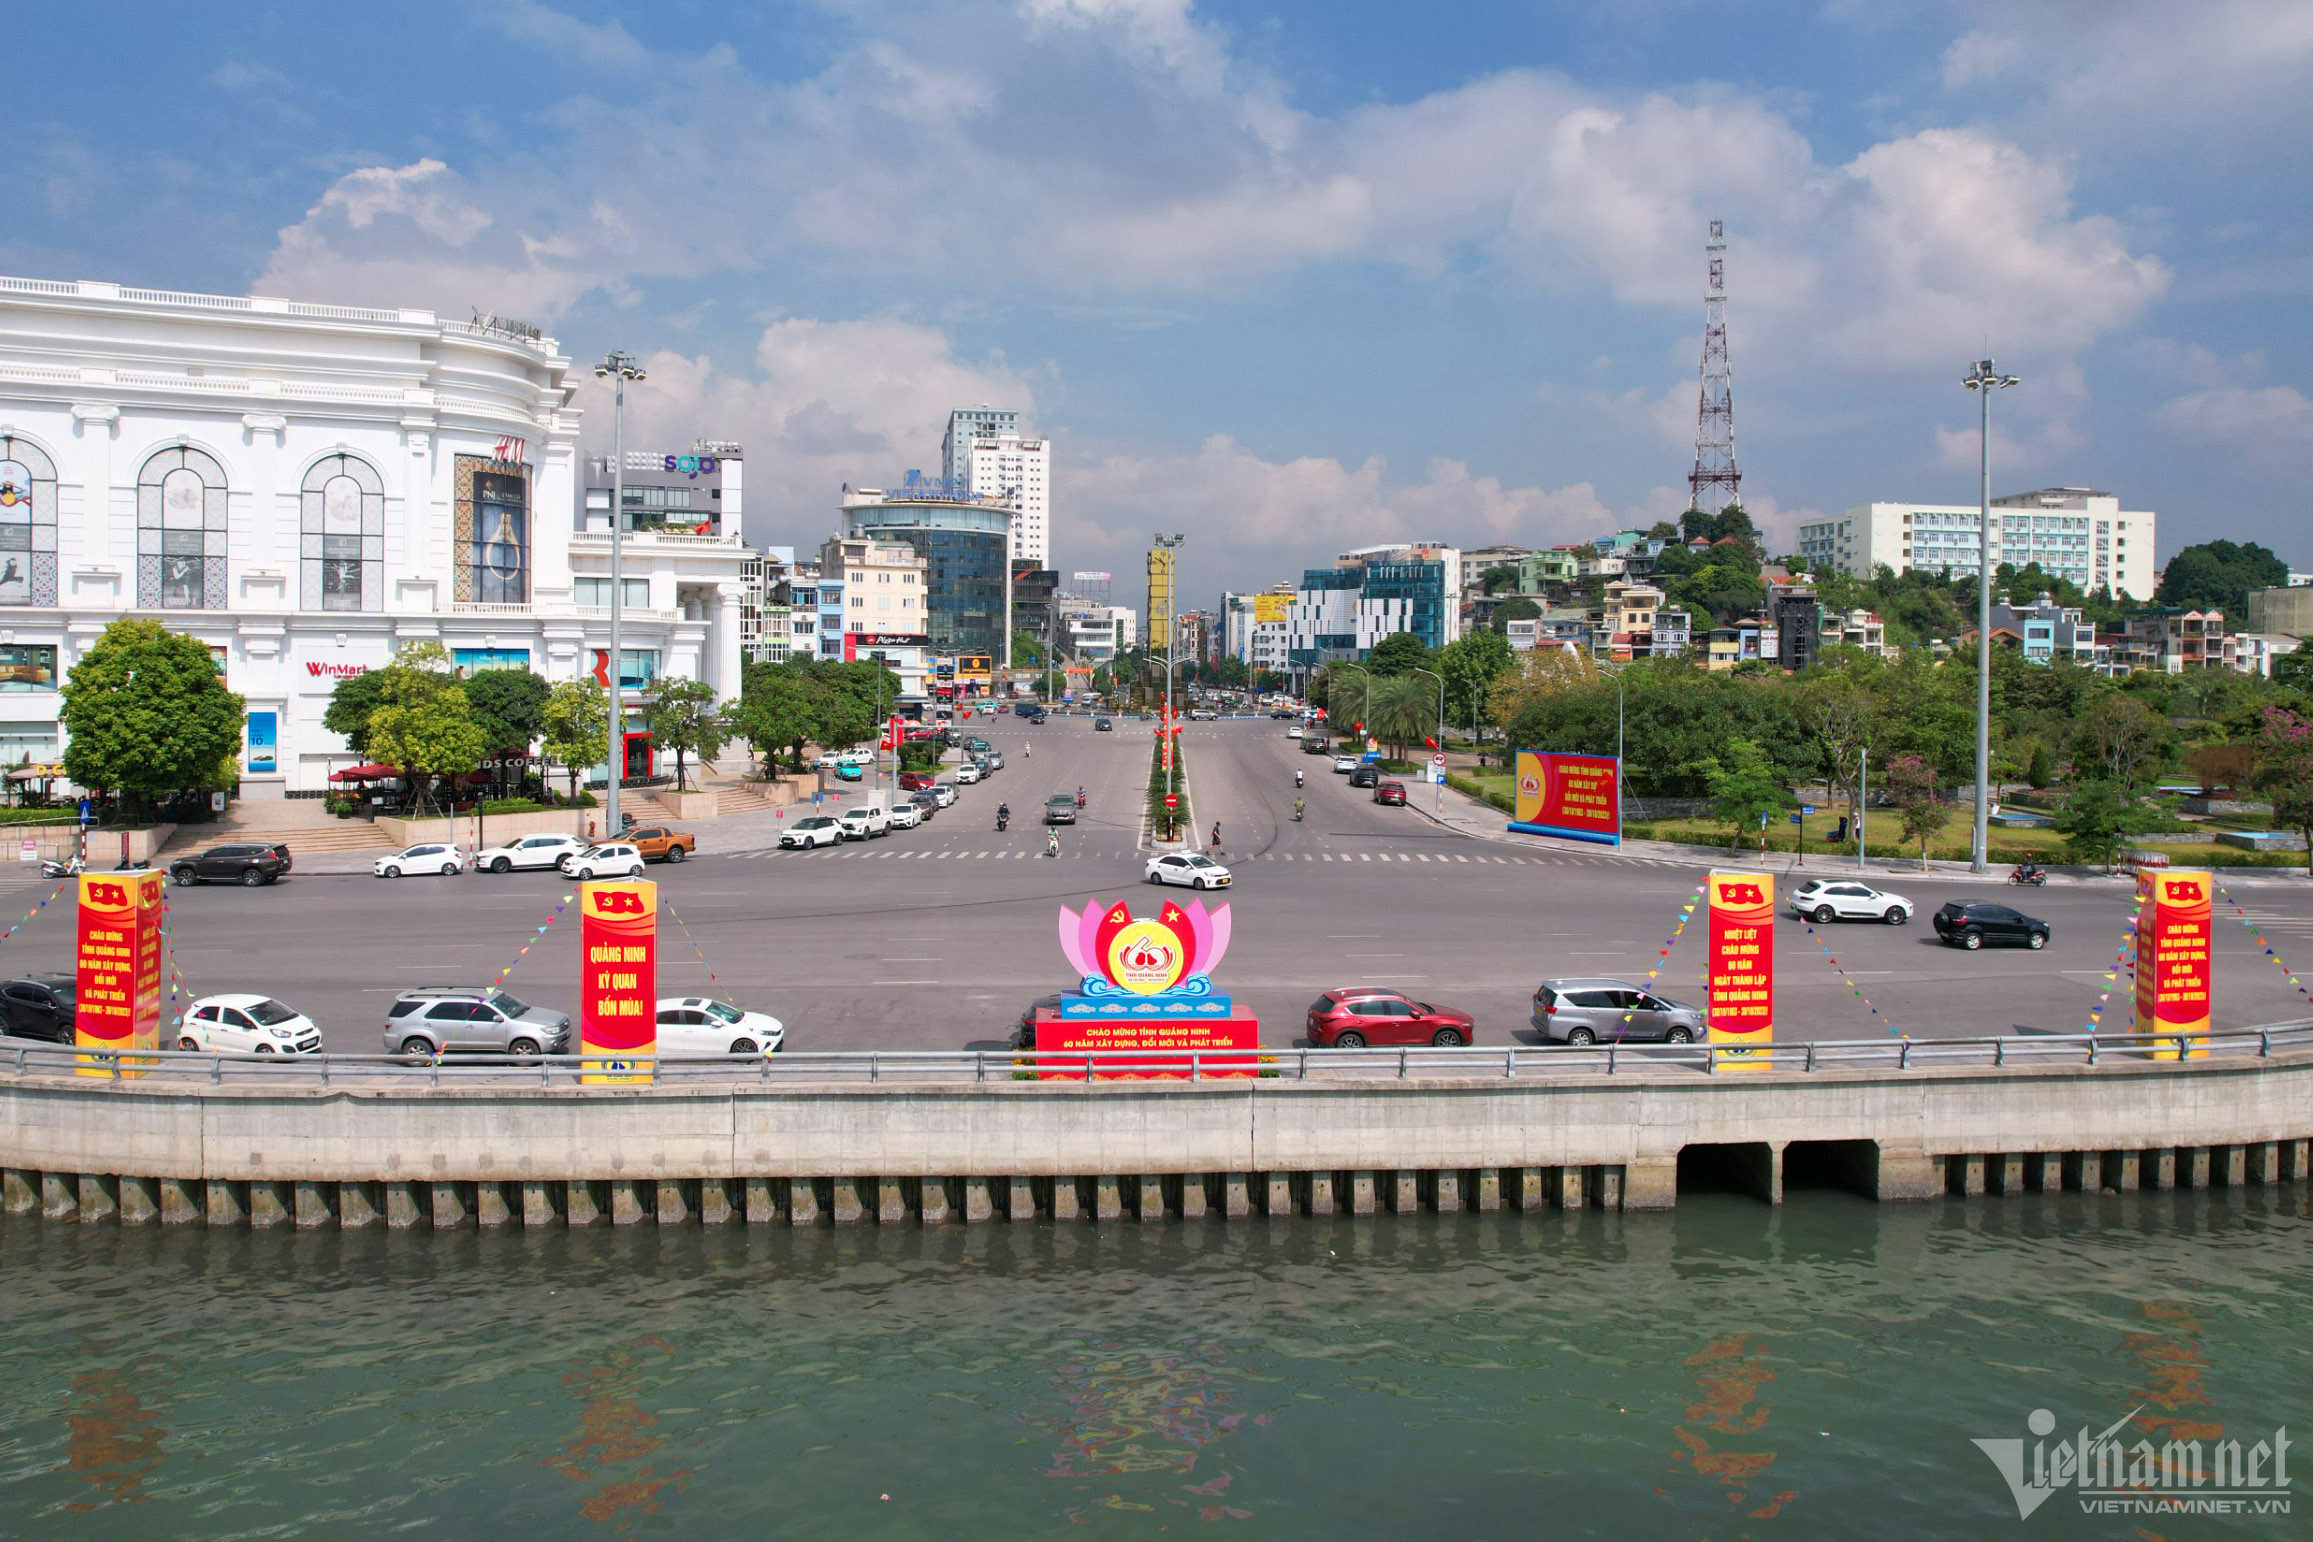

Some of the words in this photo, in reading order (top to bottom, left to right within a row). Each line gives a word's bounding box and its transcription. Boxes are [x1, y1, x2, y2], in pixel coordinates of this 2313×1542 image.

[876, 636, 895, 644] Pizza
[896, 636, 910, 644] Hut
[590, 942, 621, 964] QUẢNG
[623, 947, 646, 962] NINH
[598, 970, 610, 989] KỲ
[612, 974, 636, 991] QUAN
[598, 995, 617, 1016] BỐN
[619, 996, 643, 1016] MÙA!
[1086, 1027, 1111, 1036] CHÀO
[1112, 1028, 1137, 1036] MỪNG
[1139, 1027, 1157, 1036] TỈNH
[1159, 1028, 1188, 1036] QUẢNG
[1191, 1028, 1210, 1036] NINH
[1114, 1040, 1140, 1048] DỰNG,
[1142, 1036, 1157, 1047] ĐỔI
[1159, 1038, 1175, 1046] MỚI
[1176, 1038, 1188, 1046] VÀ
[1190, 1038, 1210, 1046] PHÁT
[1211, 1036, 1233, 1046] TRIỂN
